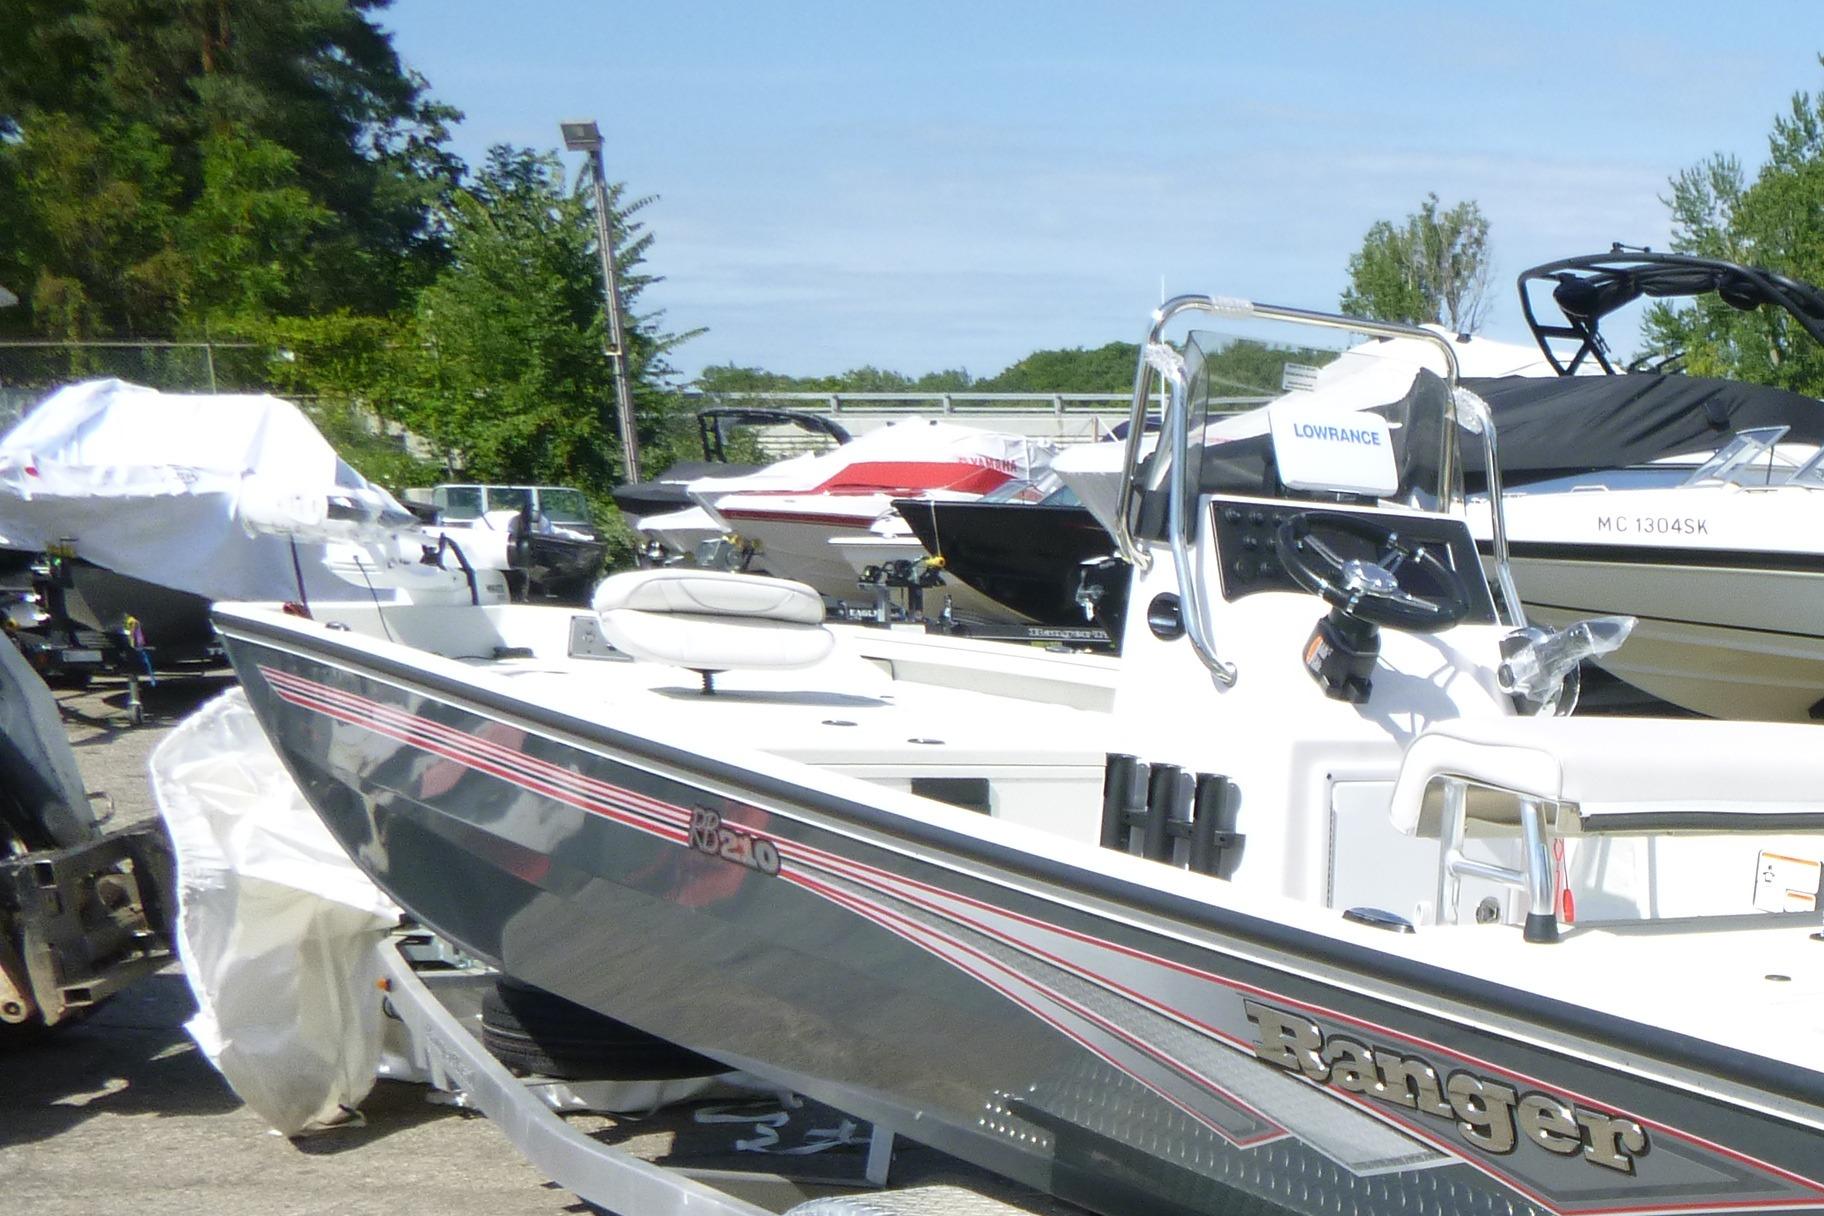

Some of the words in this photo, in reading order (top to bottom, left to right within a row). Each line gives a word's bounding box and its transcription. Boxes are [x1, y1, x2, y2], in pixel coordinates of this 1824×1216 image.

[1293, 423, 1381, 446] LOWRANCE
[1598, 516, 1628, 532] MC
[1636, 517, 1708, 535] 1304SK
[1243, 998, 1652, 1176] Ranger
